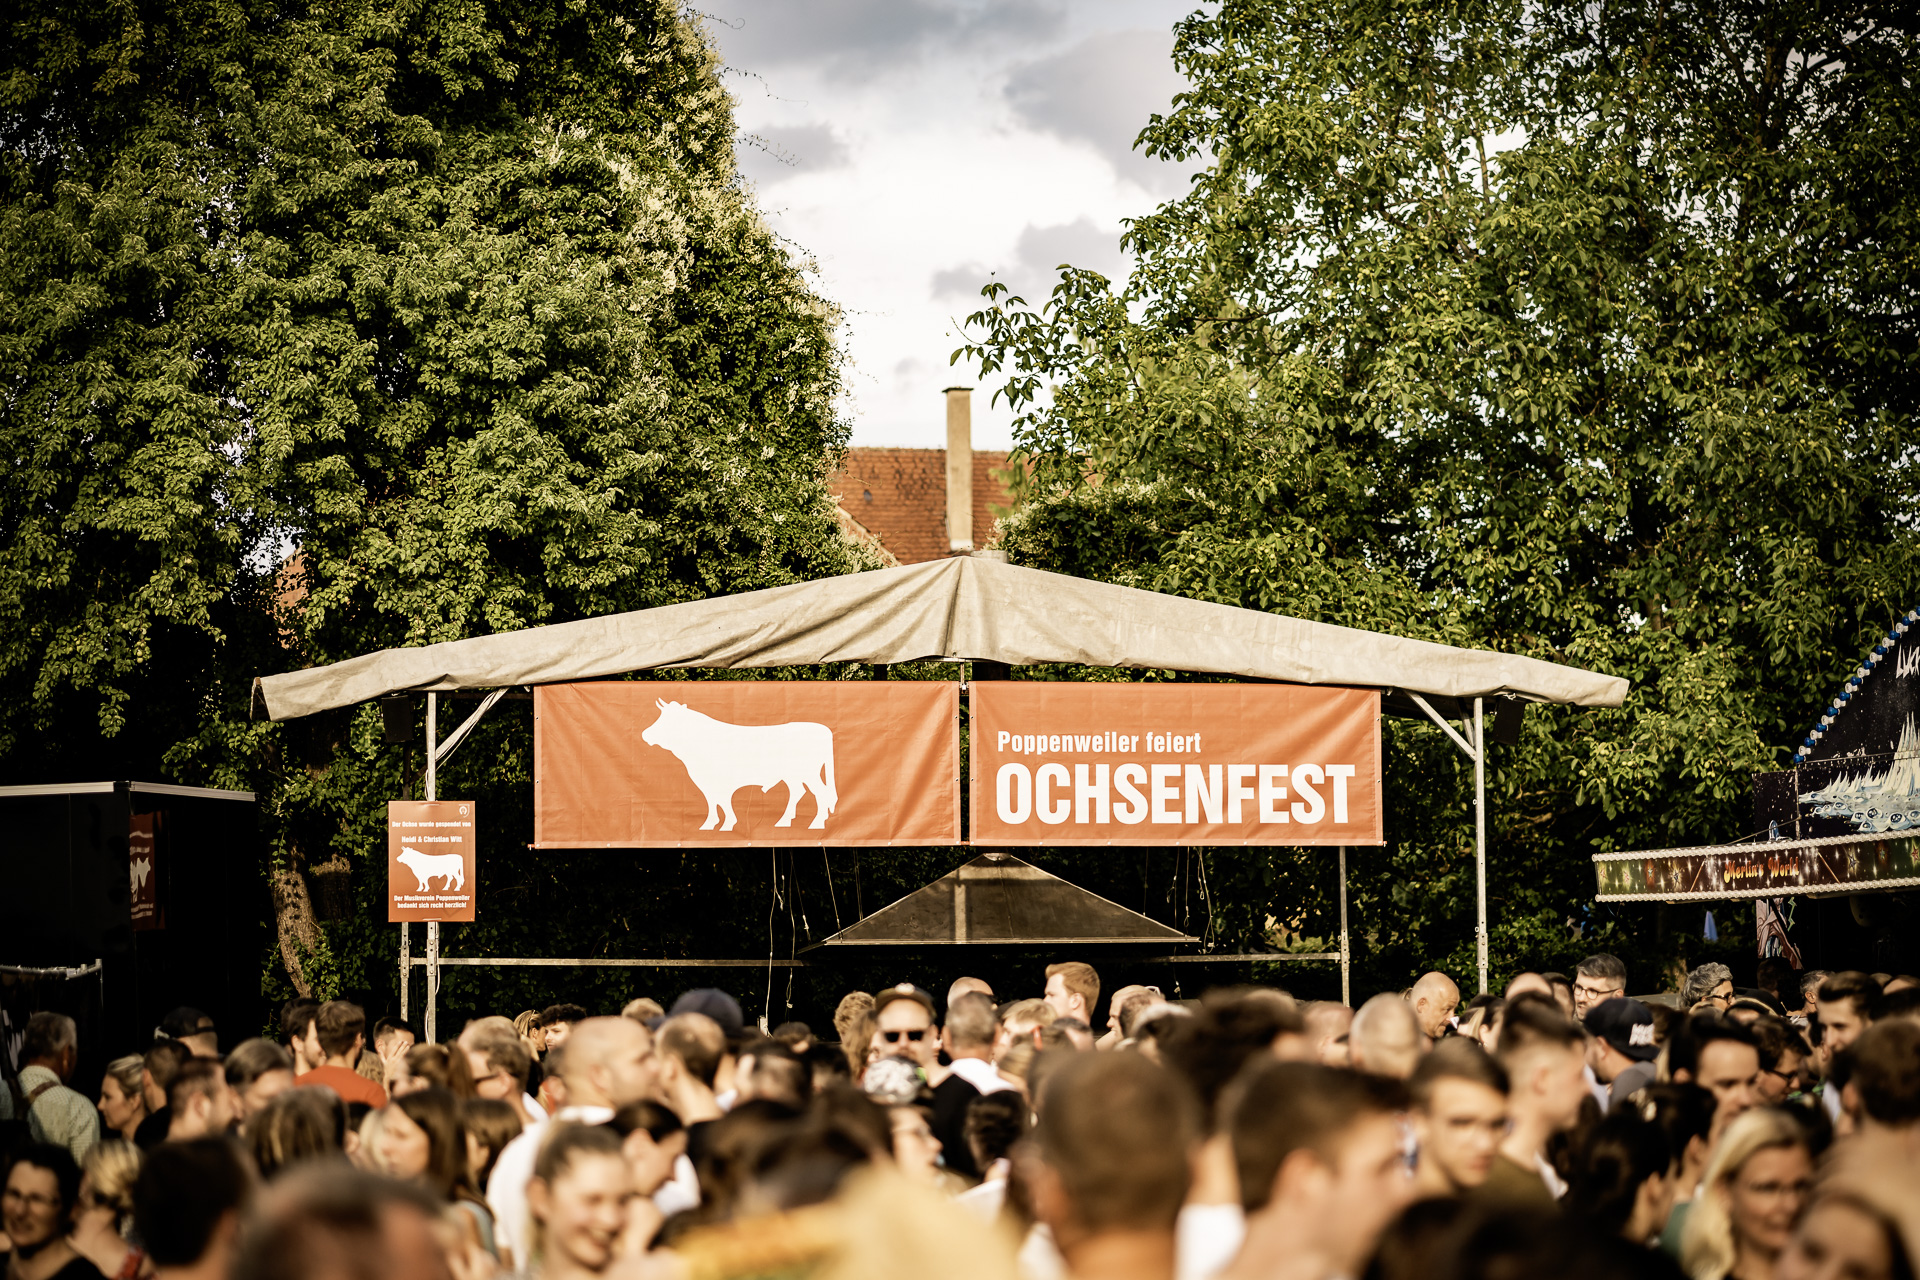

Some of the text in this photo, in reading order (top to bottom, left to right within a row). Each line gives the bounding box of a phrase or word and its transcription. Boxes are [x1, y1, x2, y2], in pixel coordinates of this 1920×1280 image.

[997, 731, 1202, 755] Poppenweiler feiert
[996, 763, 1356, 825] OCHSENFEST
[1723, 856, 1799, 884] Merlin's World
